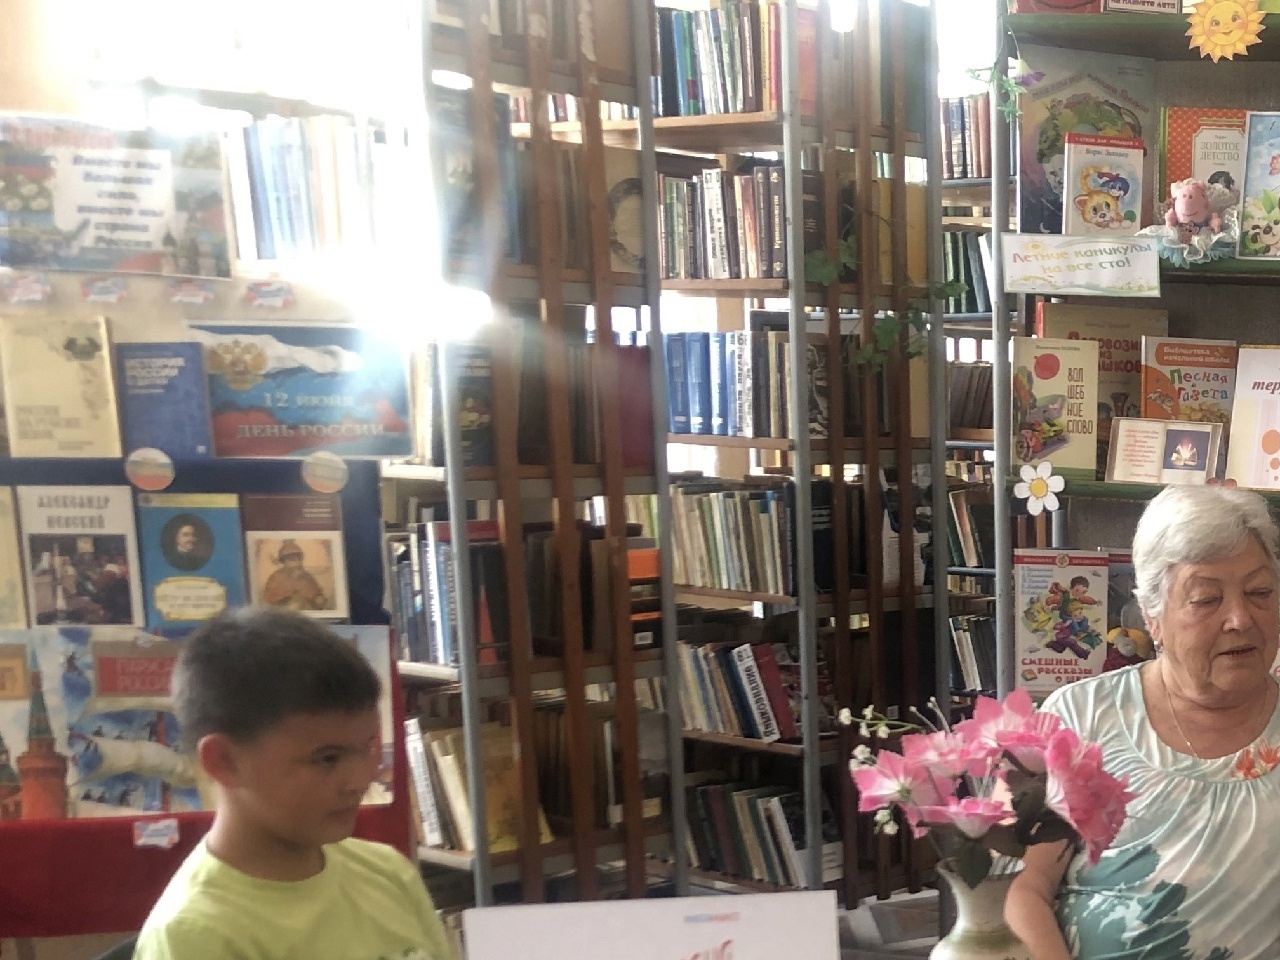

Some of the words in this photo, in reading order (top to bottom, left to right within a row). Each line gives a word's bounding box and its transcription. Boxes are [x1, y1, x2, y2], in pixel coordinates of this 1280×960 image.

[1200, 141, 1240, 151] ЗОЛОТОЕ
[1200, 151, 1240, 161] ДЕТСТВО
[1012, 251, 1068, 264] Летние
[1074, 243, 1153, 258] каникулы
[1042, 263, 1063, 274] на
[1067, 261, 1094, 272] все
[1099, 257, 1131, 269] сто!
[1067, 367, 1084, 383] ВОЛ
[1067, 384, 1085, 399] ШЕБ
[263, 391, 289, 408] 12
[1067, 402, 1083, 417] НОЕ
[236, 424, 295, 438] ДЕНЬ
[297, 424, 384, 438] РОССИИ
[1066, 419, 1094, 435] СЛОВО
[1021, 658, 1080, 666] СМЕШНЫЕ
